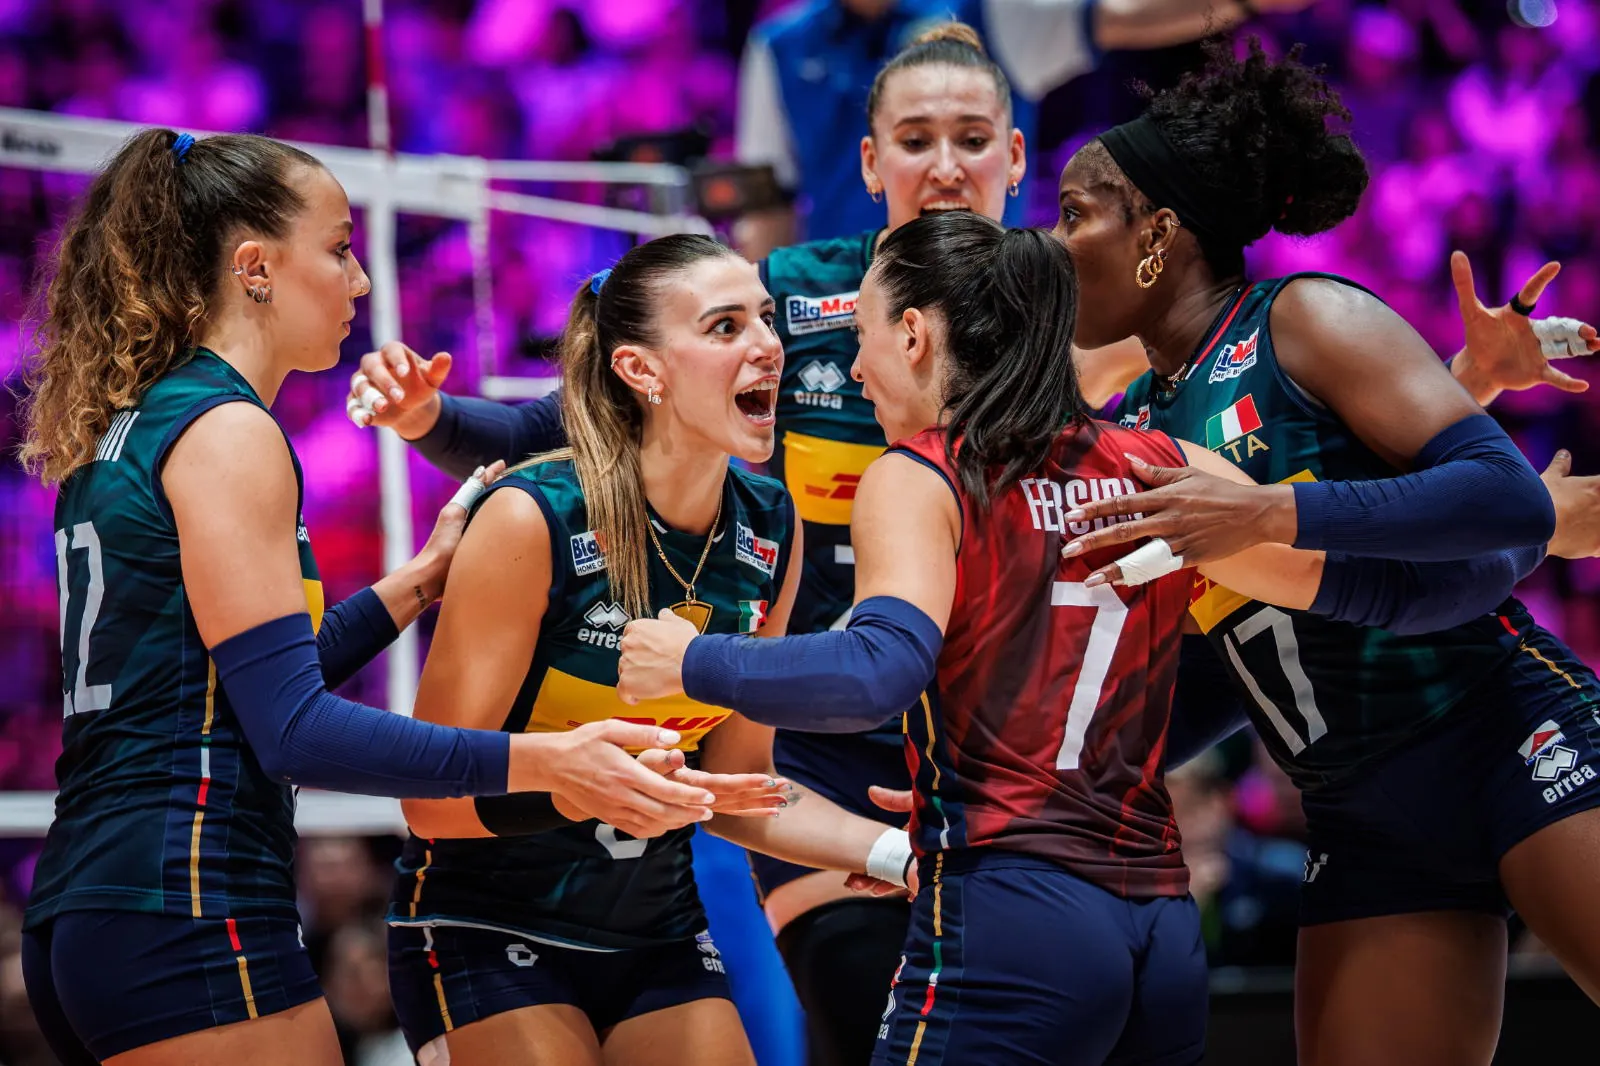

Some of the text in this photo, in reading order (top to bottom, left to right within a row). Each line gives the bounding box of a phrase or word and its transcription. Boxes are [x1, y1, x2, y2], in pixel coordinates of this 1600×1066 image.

[790, 298, 859, 320] BigMa
[1051, 581, 1139, 770] 7
[1223, 605, 1329, 758] 17
